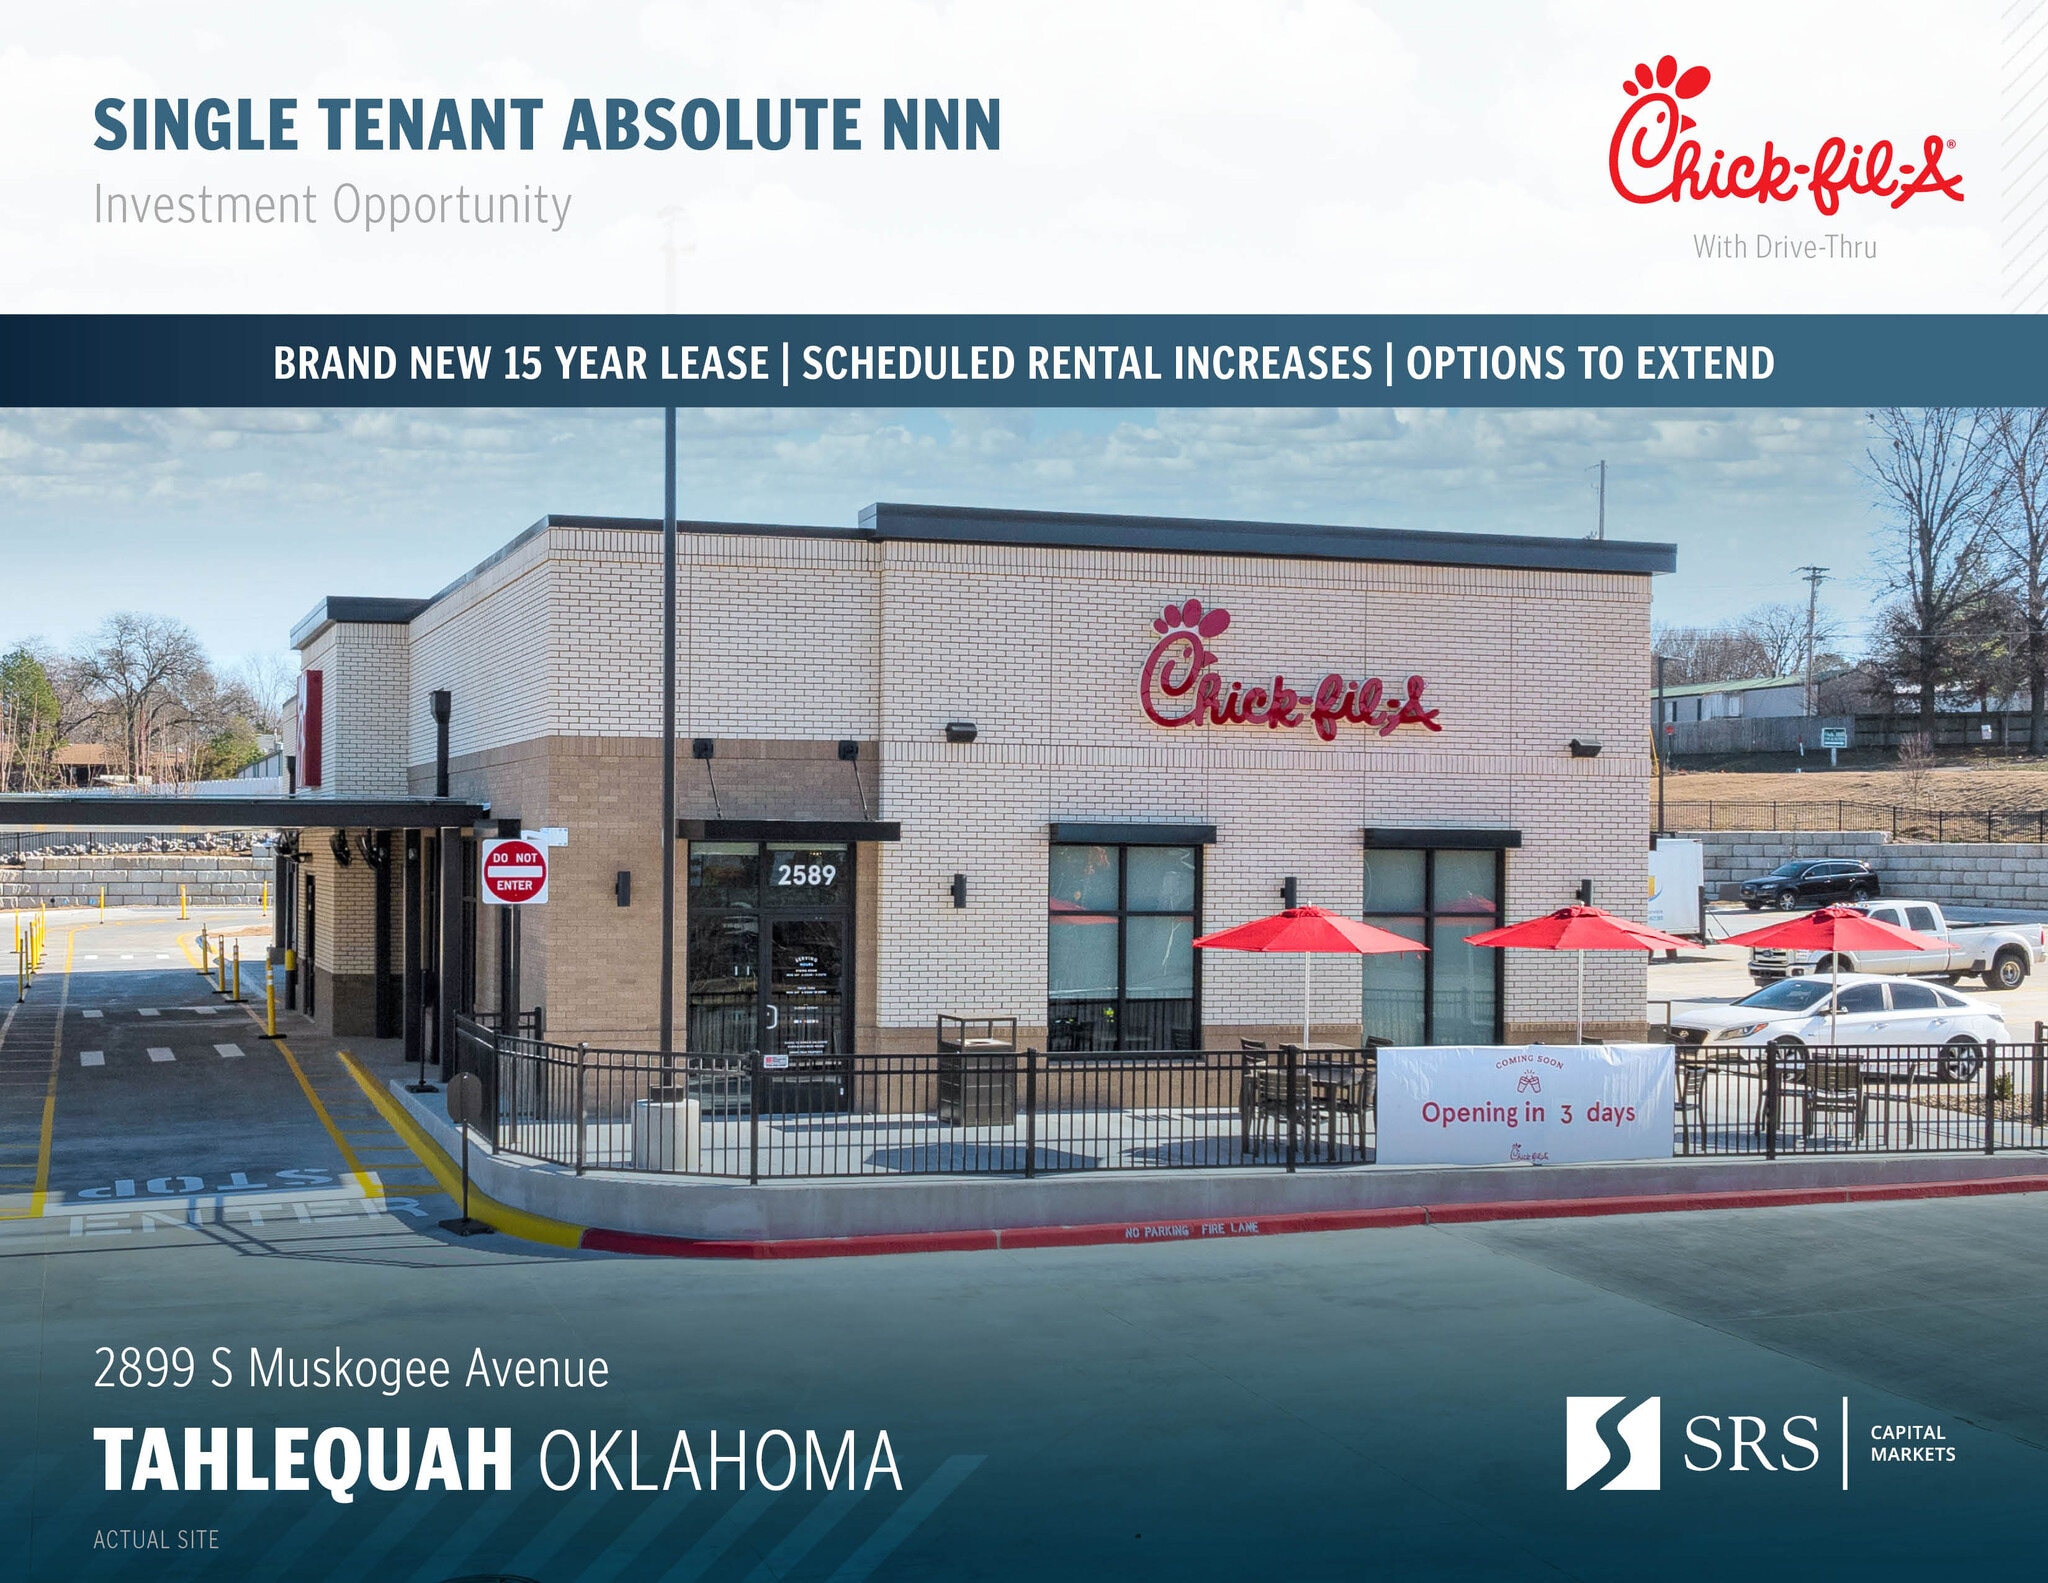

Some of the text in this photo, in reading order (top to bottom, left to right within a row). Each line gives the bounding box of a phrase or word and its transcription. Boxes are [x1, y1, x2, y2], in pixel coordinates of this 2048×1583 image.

[493, 853, 538, 863] DO NOT
[778, 864, 836, 886] 2589
[497, 880, 533, 891] ENTER
[1495, 1054, 1564, 1070] COMING SOON
[1422, 1101, 1636, 1128] Opening in 3 days
[77, 1168, 333, 1198] STOP
[69, 1197, 429, 1237] ENTER
[1125, 1221, 1259, 1239] NO PARKING FIRE LANE
